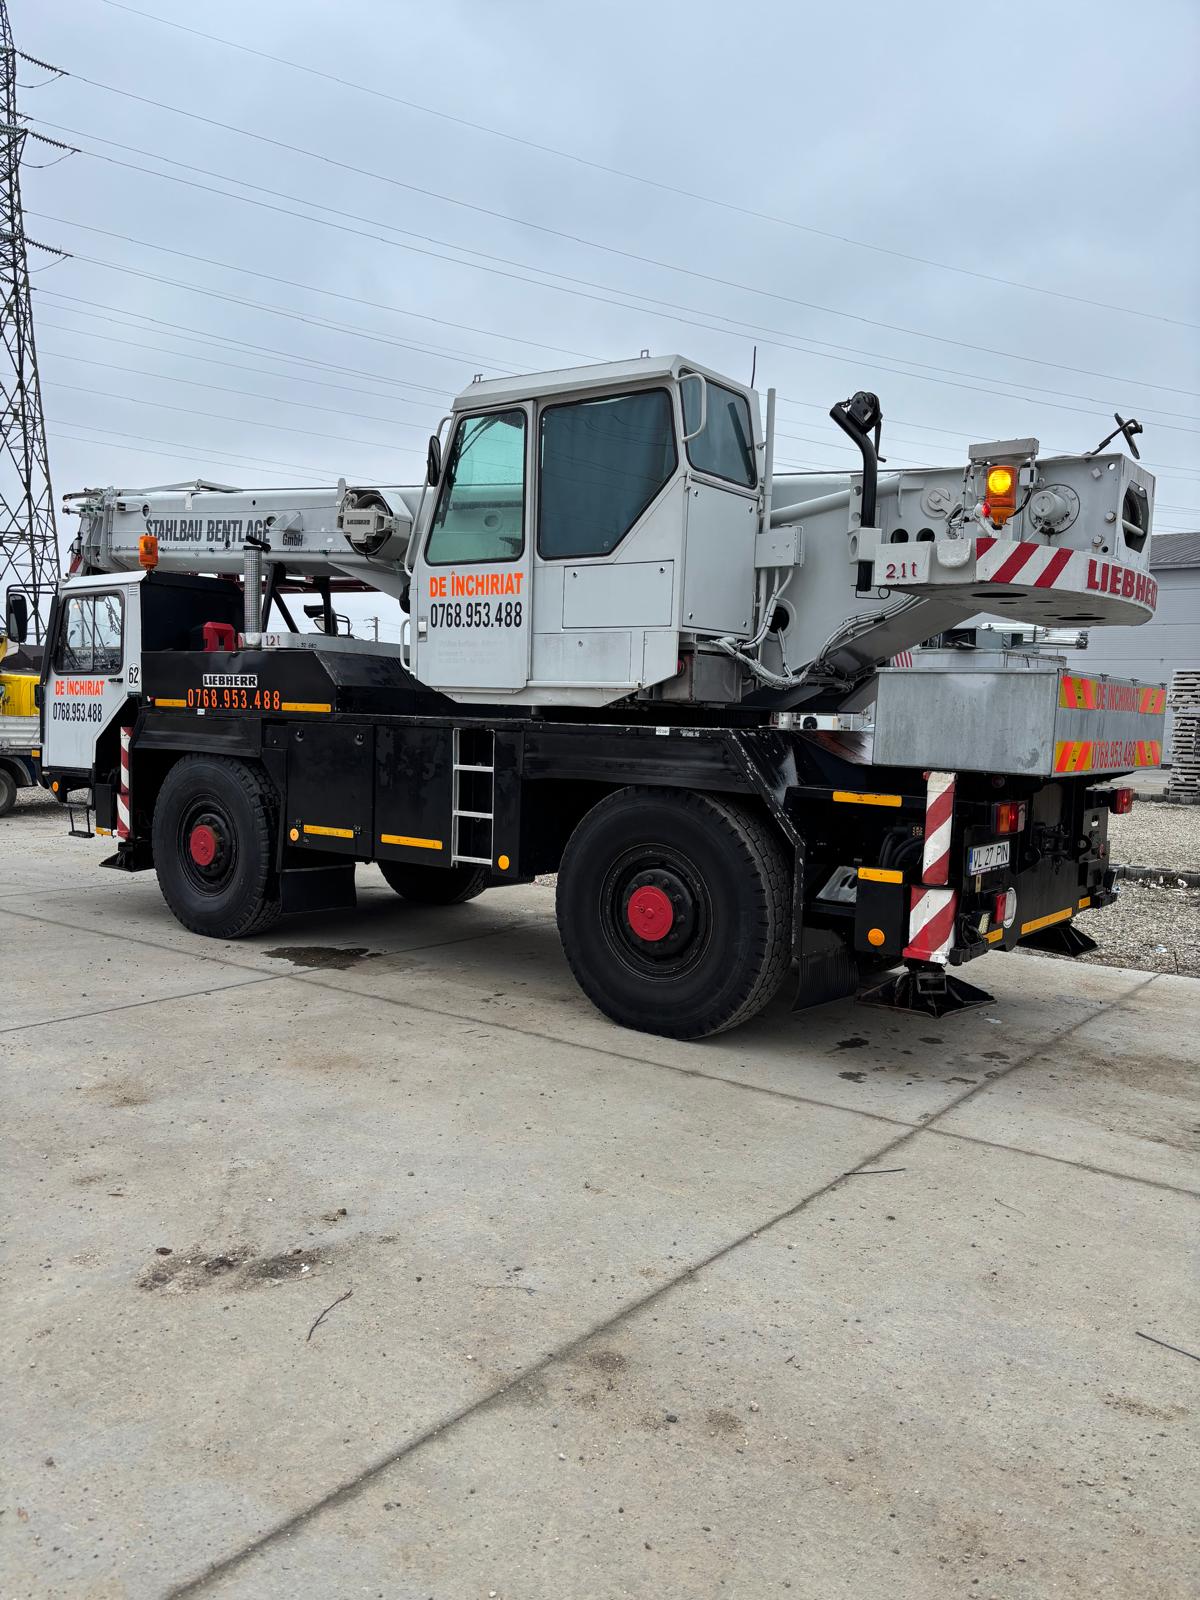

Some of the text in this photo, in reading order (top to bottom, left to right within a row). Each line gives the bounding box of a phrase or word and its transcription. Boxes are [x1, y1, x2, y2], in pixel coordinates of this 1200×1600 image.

[145, 519, 270, 543] STAHLBAU BENTLAGE
[429, 571, 524, 598] DE ÎNCHIRIAT
[430, 601, 522, 628] 0768.953.488
[128, 667, 139, 684] 62
[203, 675, 257, 687] LIEBHERR
[55, 680, 65, 696] DE
[187, 688, 280, 710] 0768.953.488
[53, 702, 103, 723] 0768.953.488
